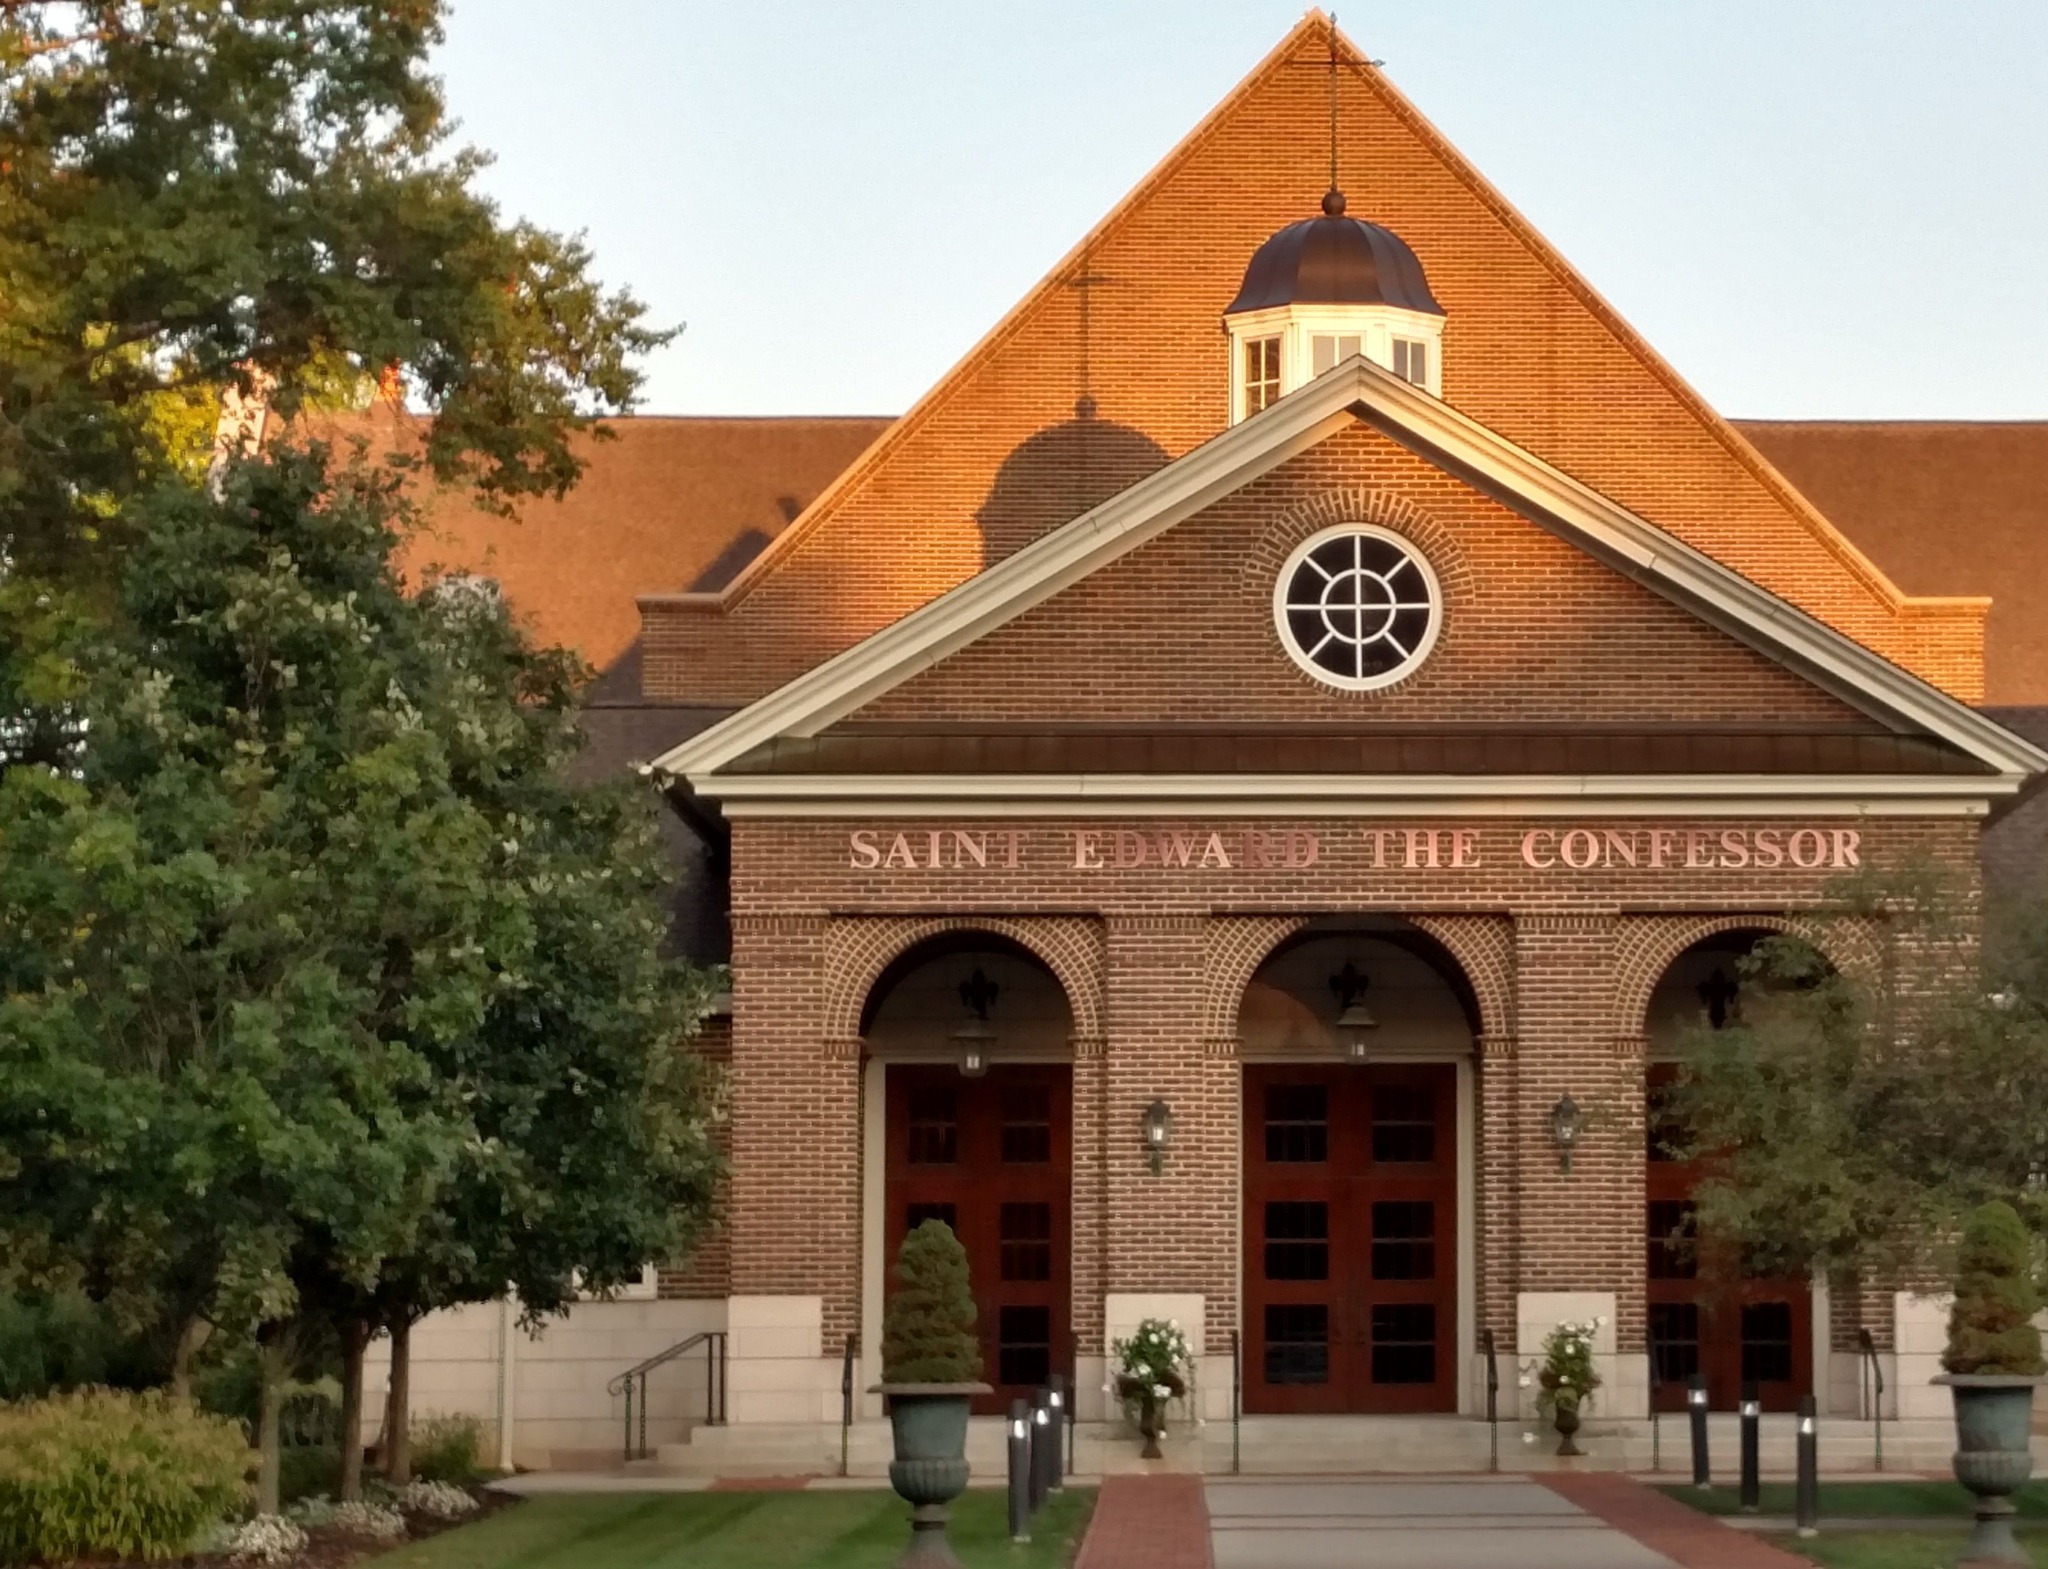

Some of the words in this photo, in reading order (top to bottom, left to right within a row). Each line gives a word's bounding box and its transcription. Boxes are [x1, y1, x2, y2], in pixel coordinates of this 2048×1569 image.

[849, 829, 1029, 869] SAINT
[1073, 829, 1319, 869] EDWARD
[1364, 828, 1481, 869] THE
[1521, 828, 1862, 869] CONFESSOR
